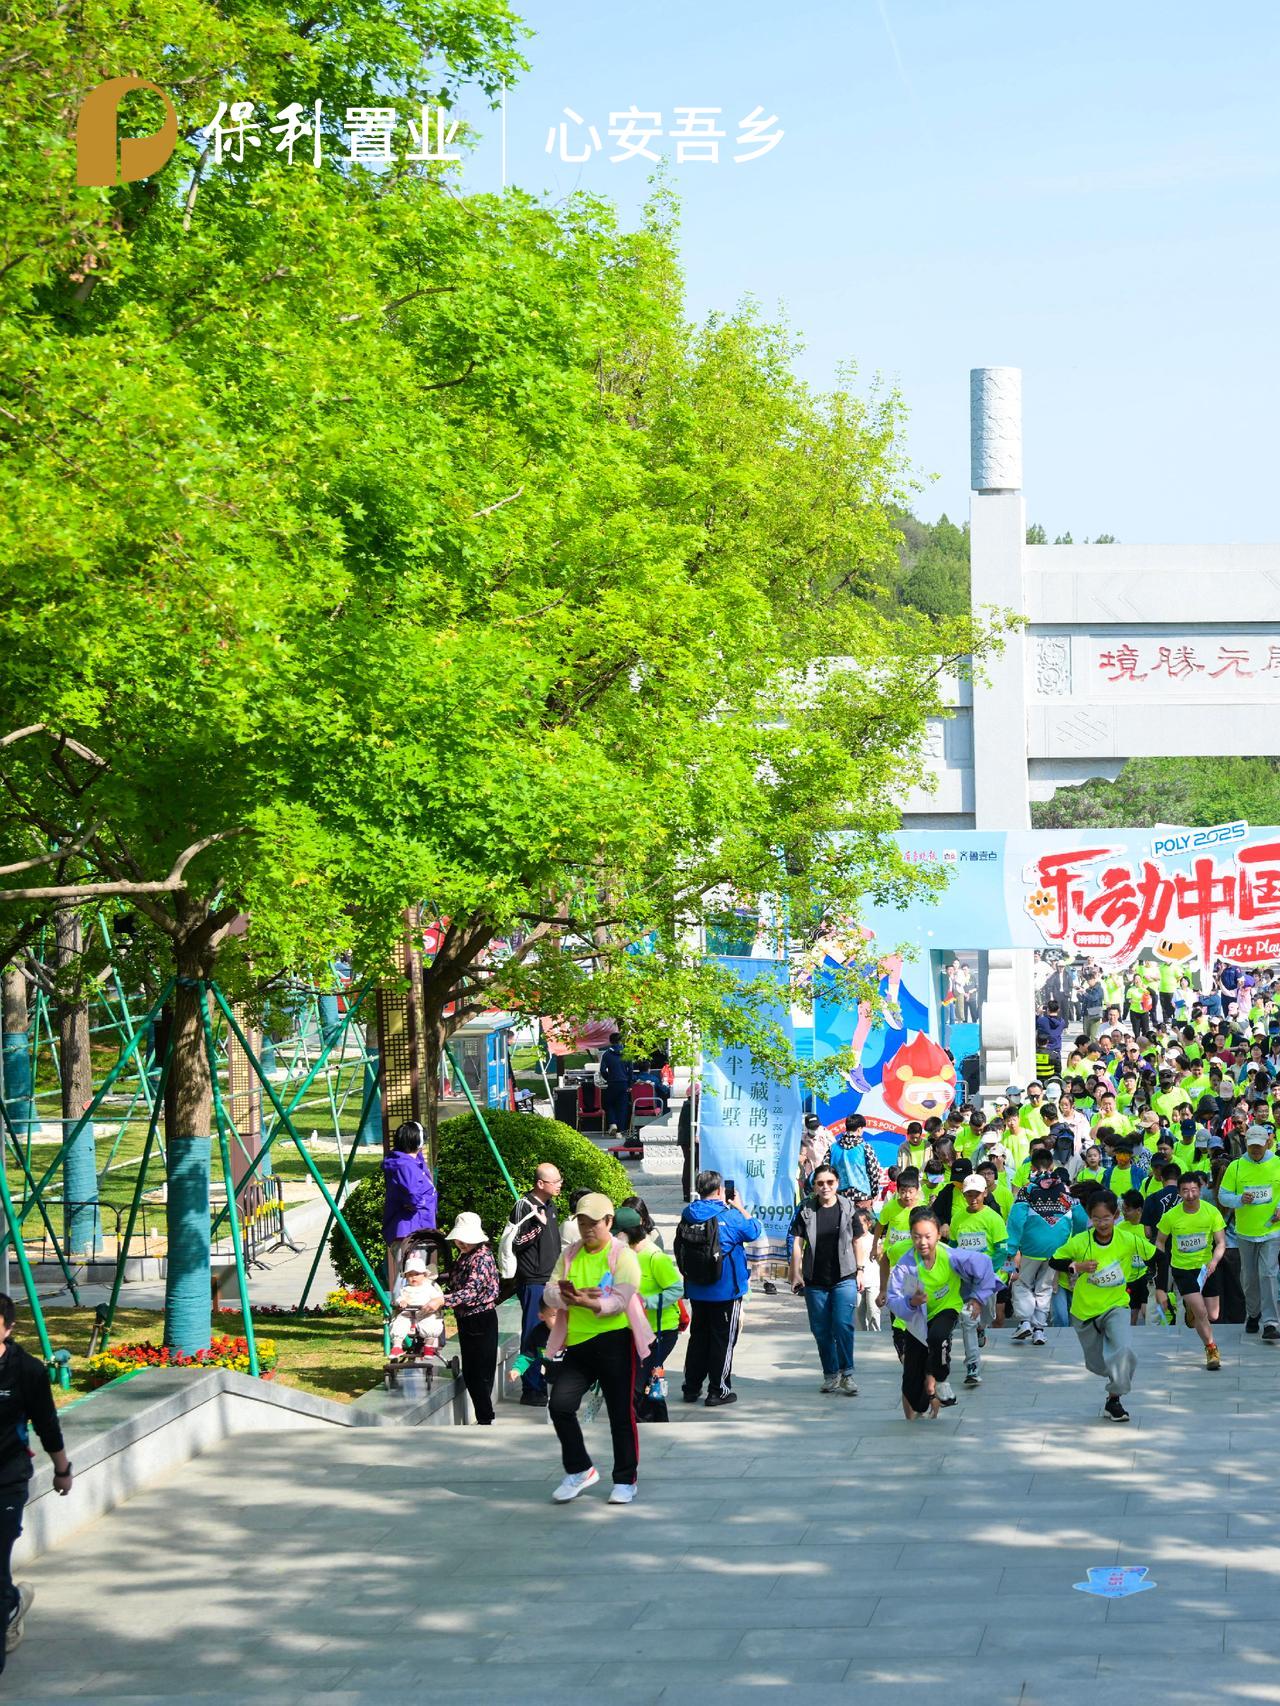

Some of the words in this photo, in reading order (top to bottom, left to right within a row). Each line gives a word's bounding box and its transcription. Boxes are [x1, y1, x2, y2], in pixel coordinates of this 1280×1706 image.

[1154, 835, 1191, 855] POLY
[1193, 823, 1246, 847] 2025
[1222, 943, 1252, 958] Let's
[960, 1238, 981, 1247] A0435
[1180, 1239, 1201, 1248] A0281
